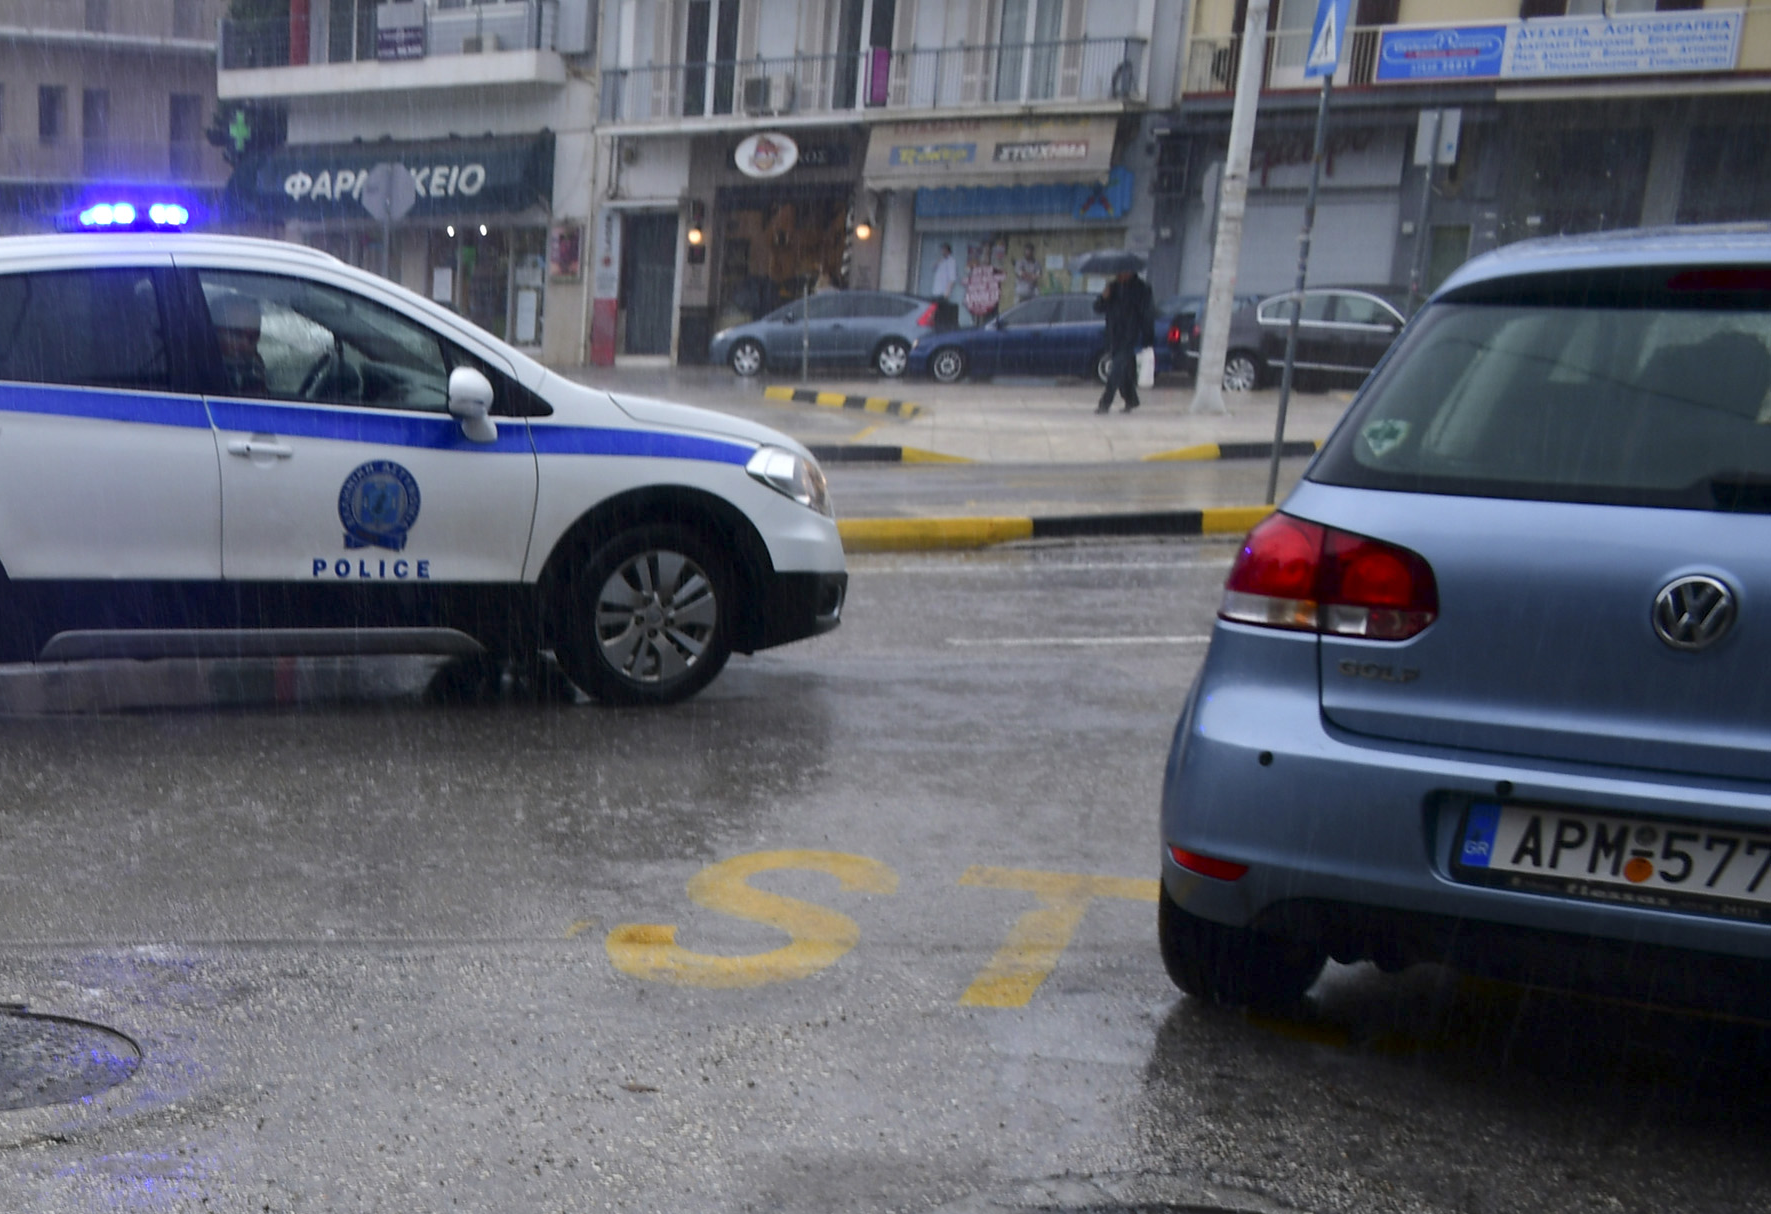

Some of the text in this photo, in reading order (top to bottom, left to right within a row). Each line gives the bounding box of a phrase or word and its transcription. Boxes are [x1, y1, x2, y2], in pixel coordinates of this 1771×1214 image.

[284, 163, 486, 201] ΦΑΡΚΕΙΟ
[312, 558, 431, 580] POLICE
[1338, 659, 1421, 683] GOLF
[1464, 839, 1489, 857] GR
